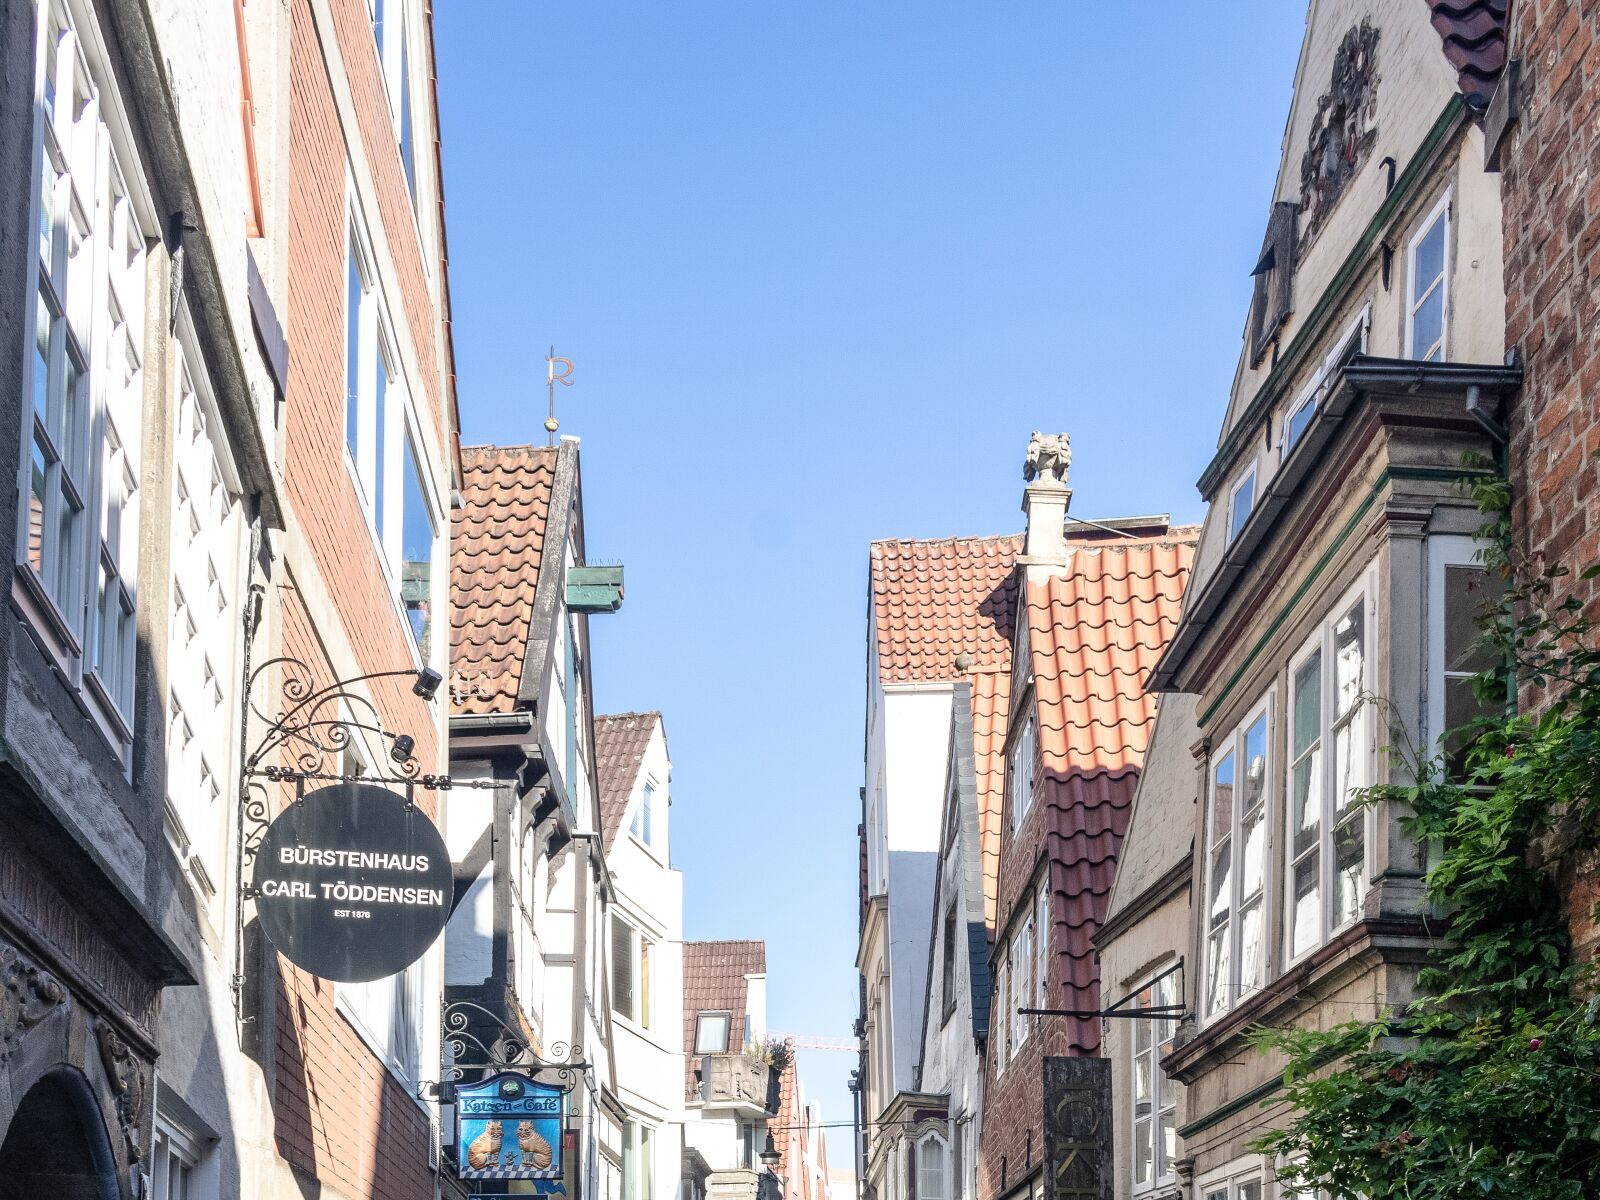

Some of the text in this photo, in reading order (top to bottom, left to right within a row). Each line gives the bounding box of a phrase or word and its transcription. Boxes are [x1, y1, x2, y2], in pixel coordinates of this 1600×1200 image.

[280, 845, 429, 872] BÜRSTENHAUS
[262, 880, 444, 906] CARL TÖDDENSEN
[334, 909, 371, 919] EST 1876
